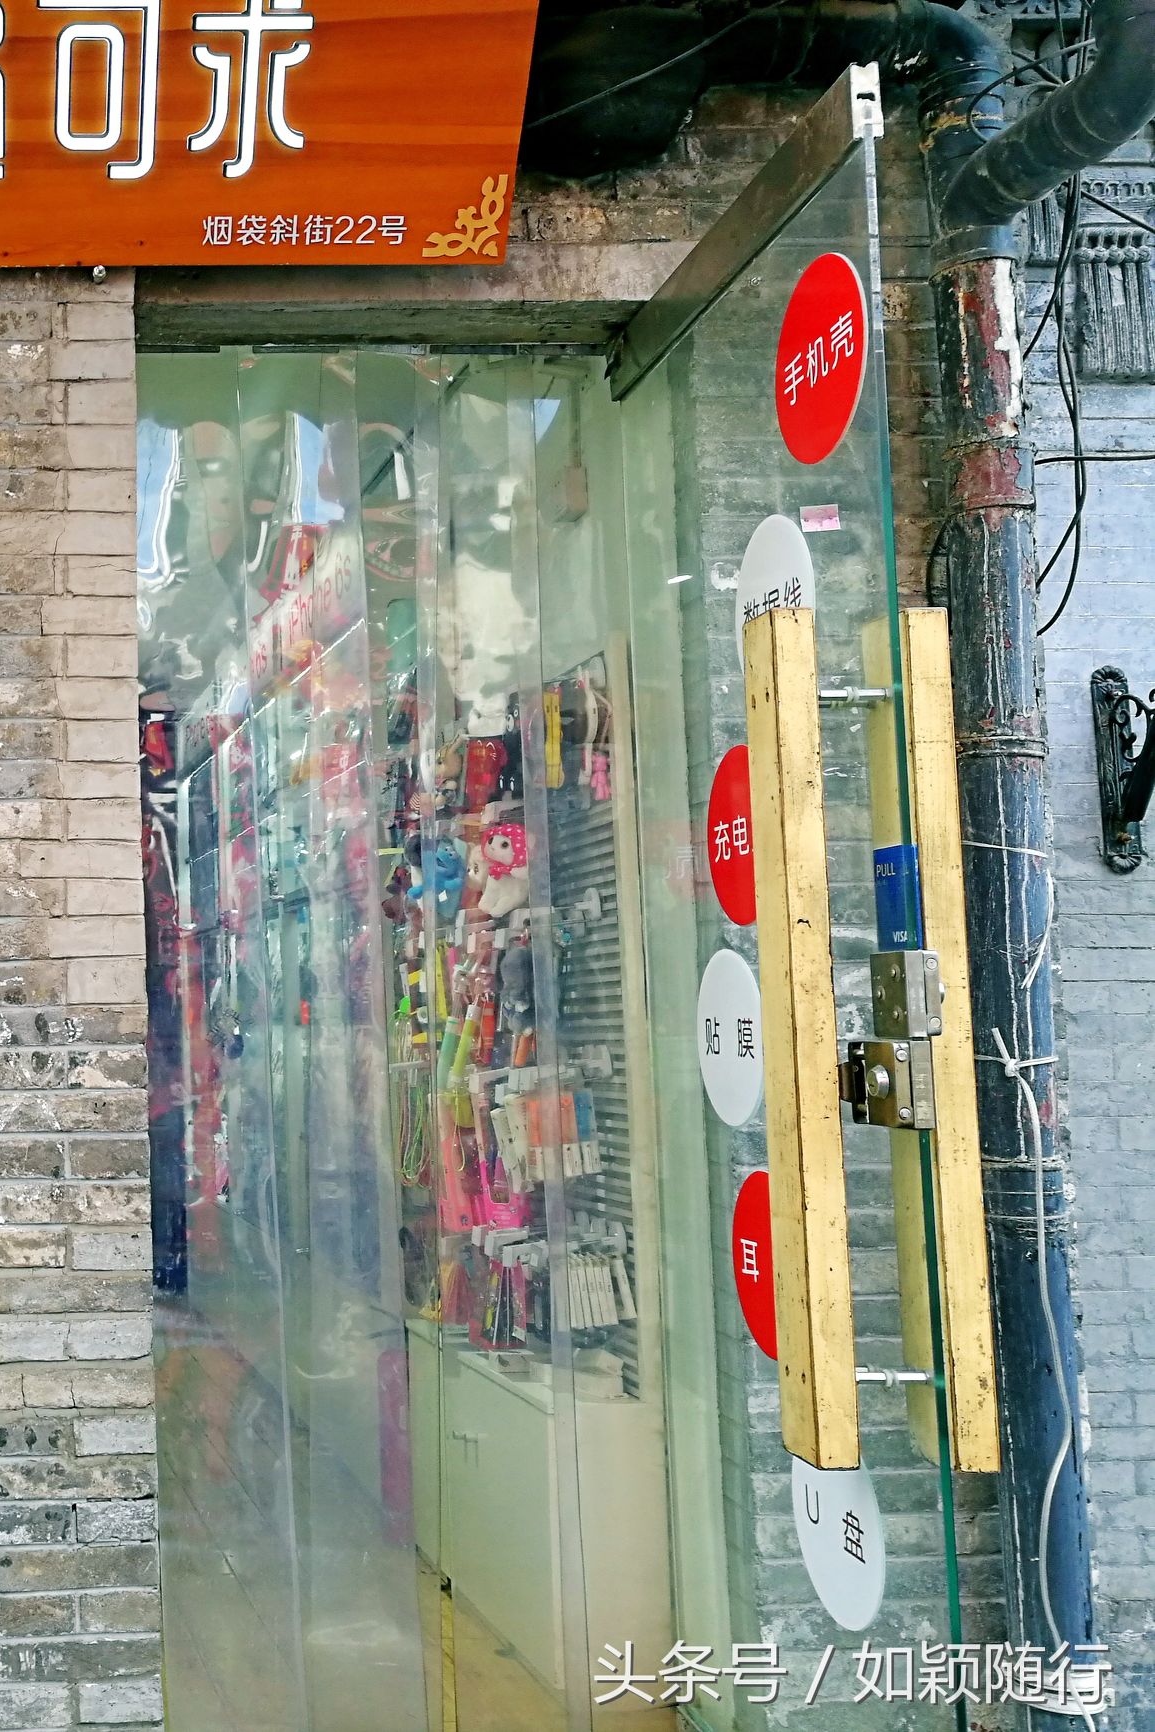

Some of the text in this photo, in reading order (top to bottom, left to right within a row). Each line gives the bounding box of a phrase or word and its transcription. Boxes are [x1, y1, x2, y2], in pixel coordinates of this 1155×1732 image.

[202, 214, 406, 247] 烟袋斜街22号
[783, 310, 855, 406] 手机壳
[876, 862, 896, 878] PULL
[893, 930, 909, 943] VISA
[705, 1017, 755, 1060] 贴膜
